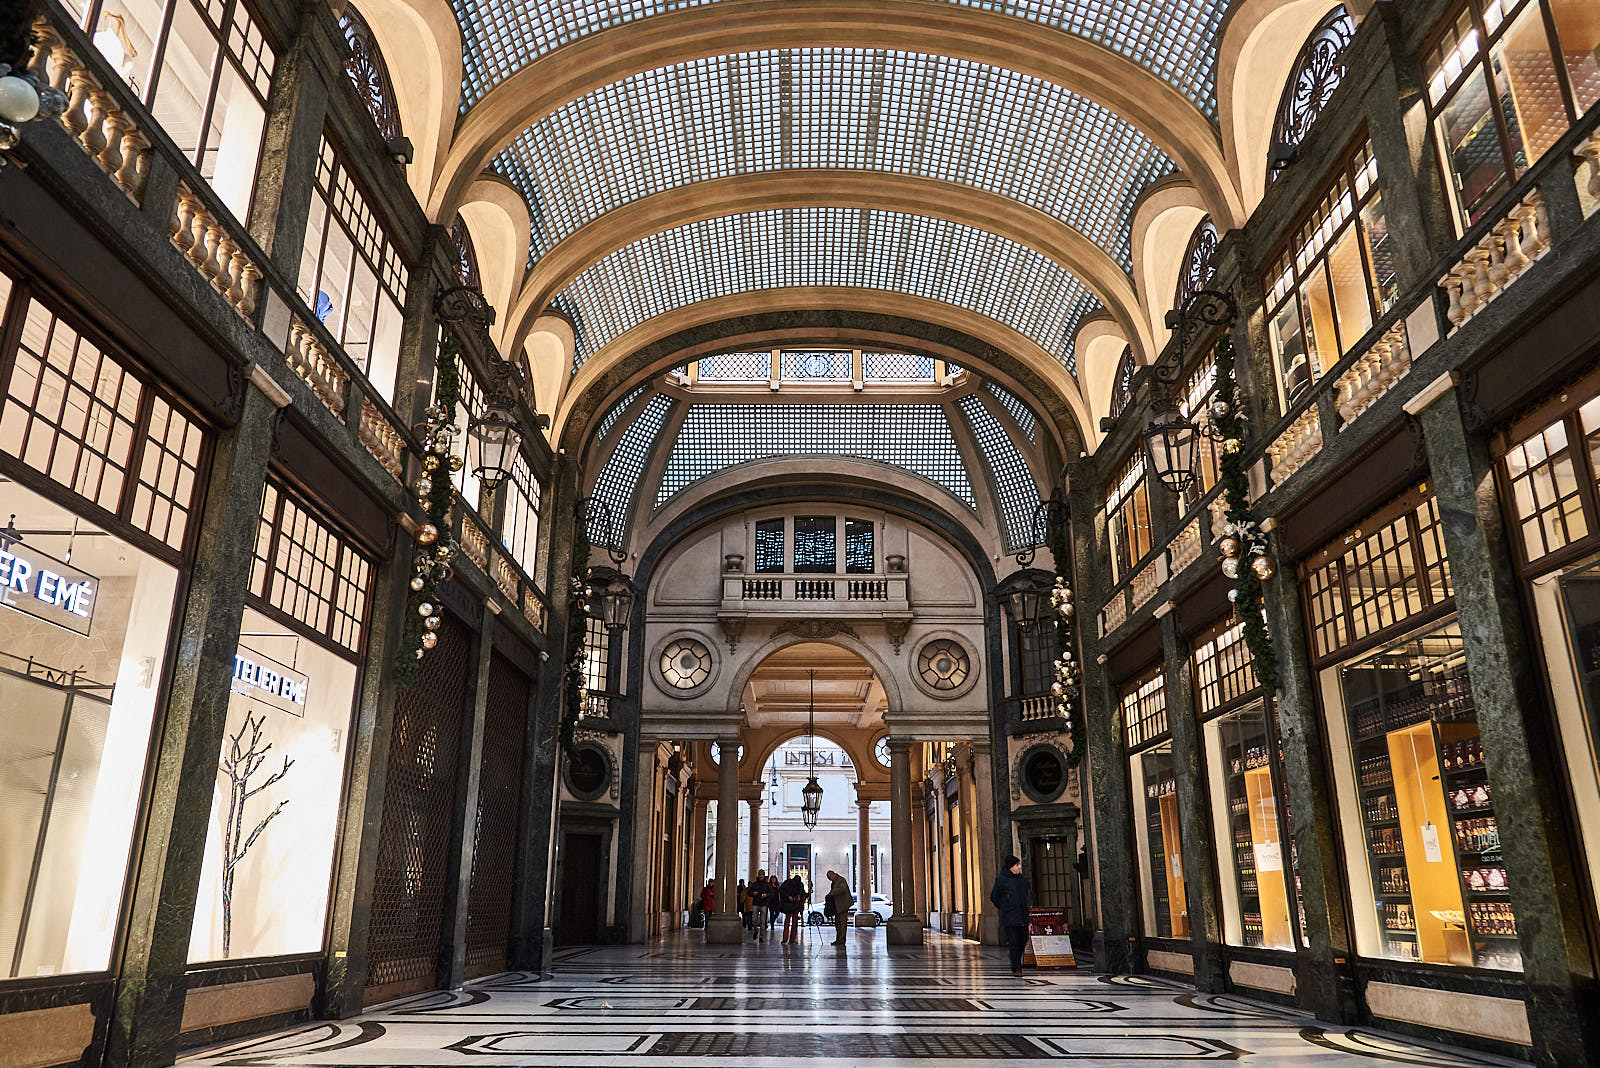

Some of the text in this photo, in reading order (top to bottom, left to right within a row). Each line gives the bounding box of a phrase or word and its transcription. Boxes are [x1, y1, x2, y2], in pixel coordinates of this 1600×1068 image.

[34, 569, 93, 618] EMÉ
[233, 654, 307, 706] TELIER EMÉ
